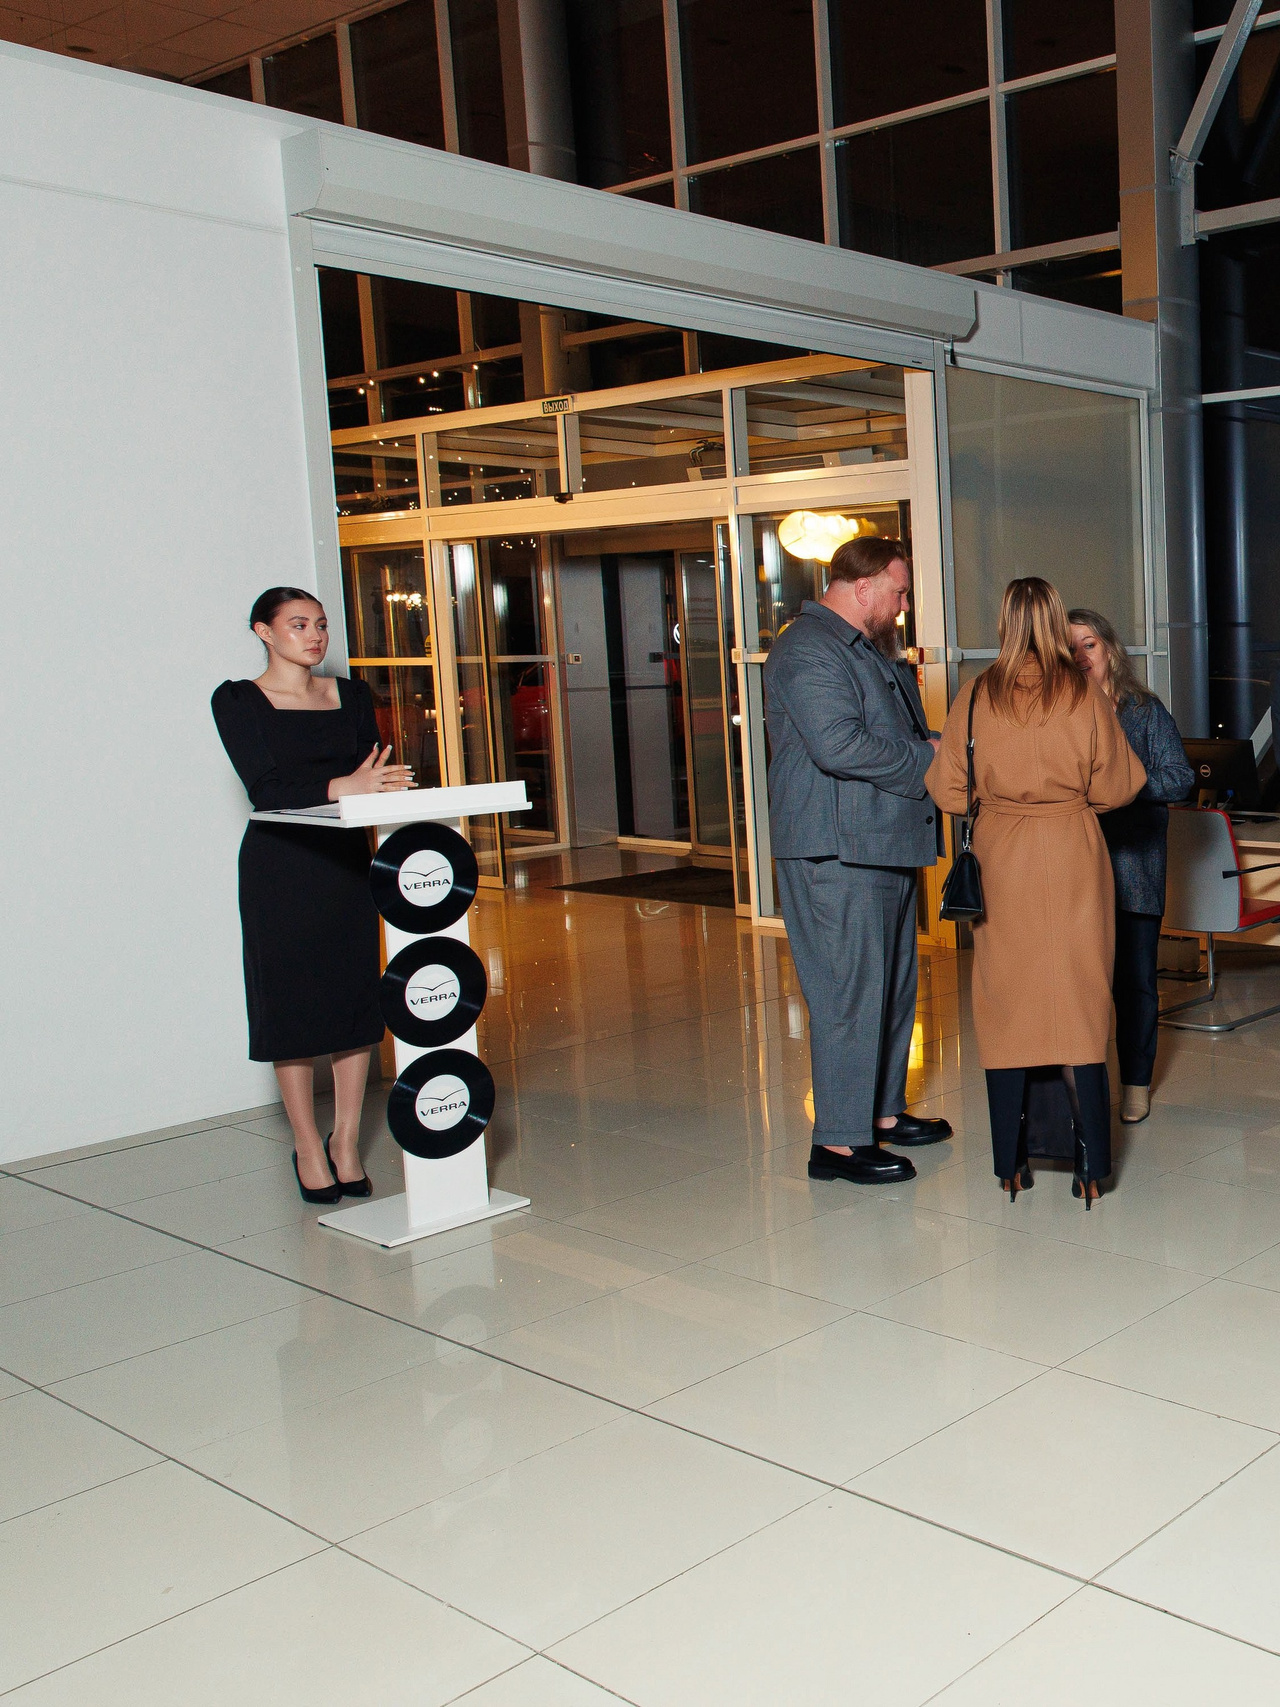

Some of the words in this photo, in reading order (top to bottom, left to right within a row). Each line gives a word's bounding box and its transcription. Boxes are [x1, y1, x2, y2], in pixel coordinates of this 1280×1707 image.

[544, 400, 569, 413] ВЫХОД
[403, 878, 451, 891] VERRA
[410, 992, 457, 1006] VERRA
[421, 1101, 467, 1116] VERRA
